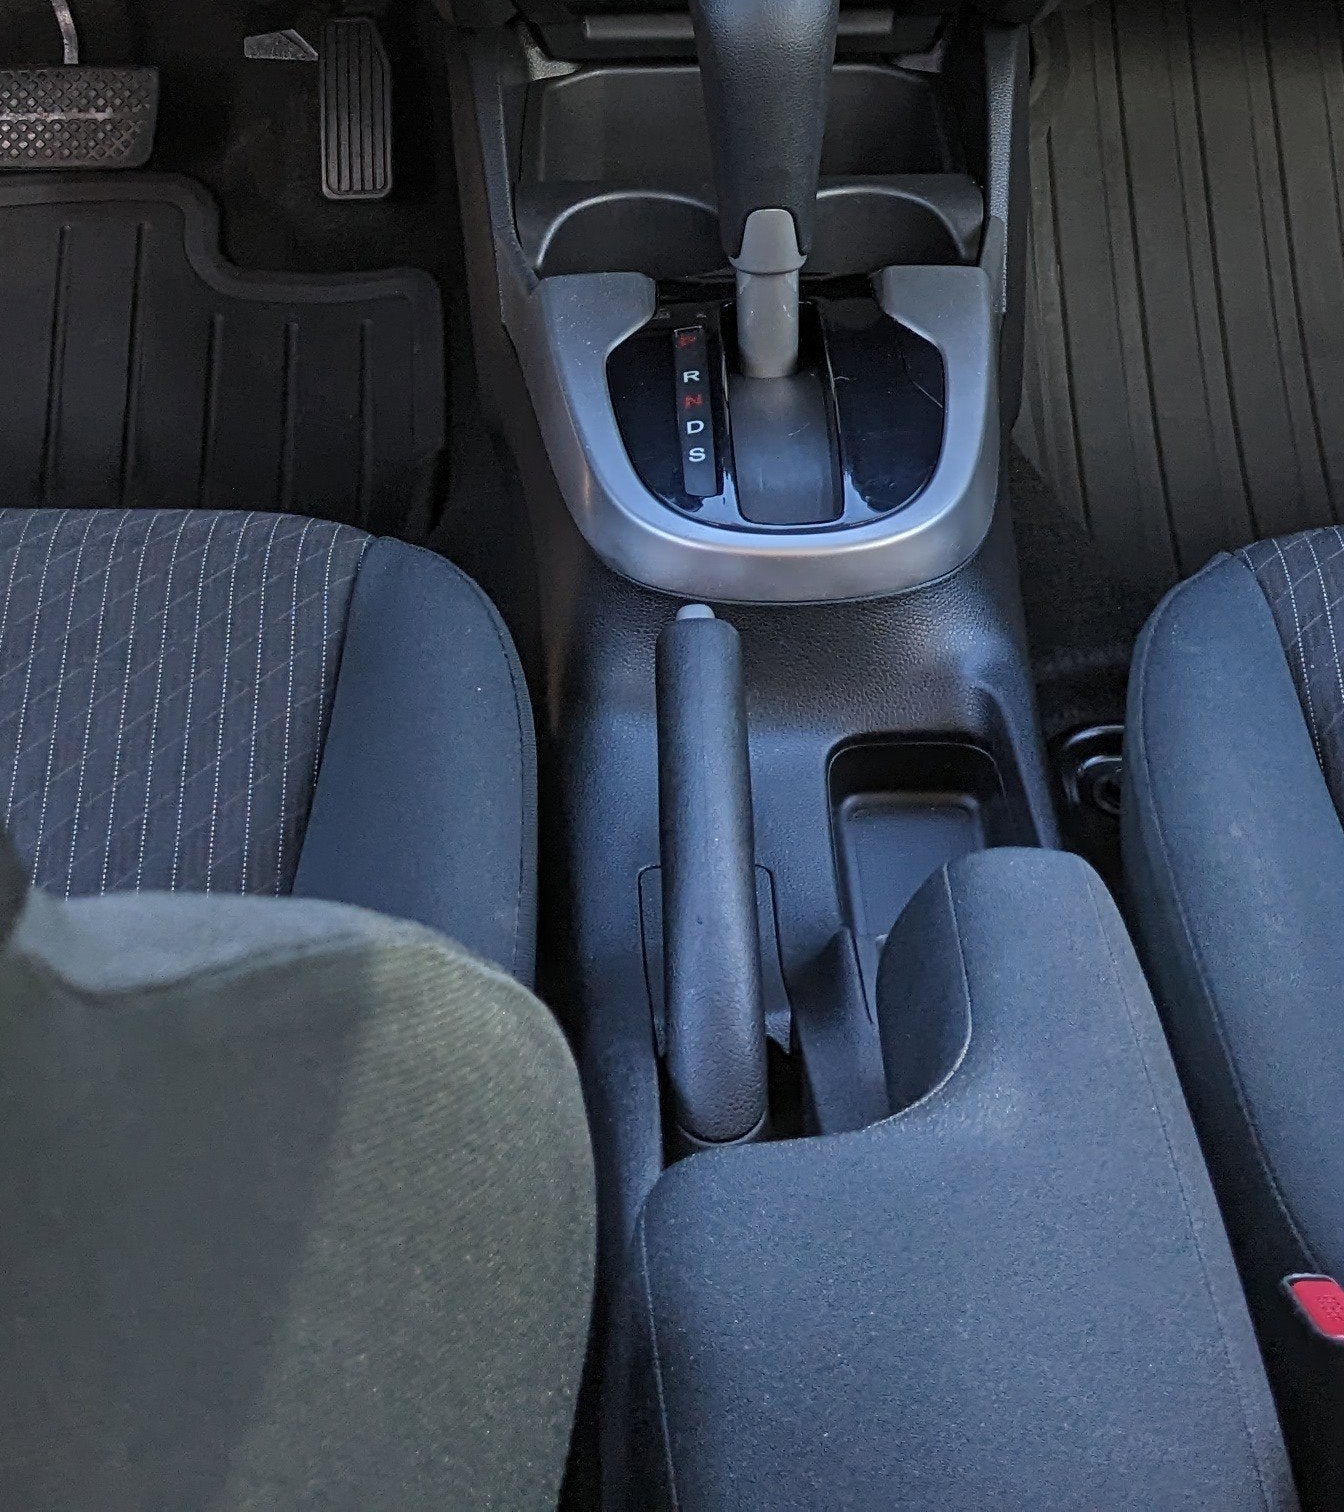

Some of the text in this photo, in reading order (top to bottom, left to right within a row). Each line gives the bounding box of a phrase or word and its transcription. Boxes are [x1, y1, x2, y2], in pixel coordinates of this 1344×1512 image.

[683, 370, 700, 383] R
[686, 420, 704, 435] D
[688, 447, 706, 462] S
